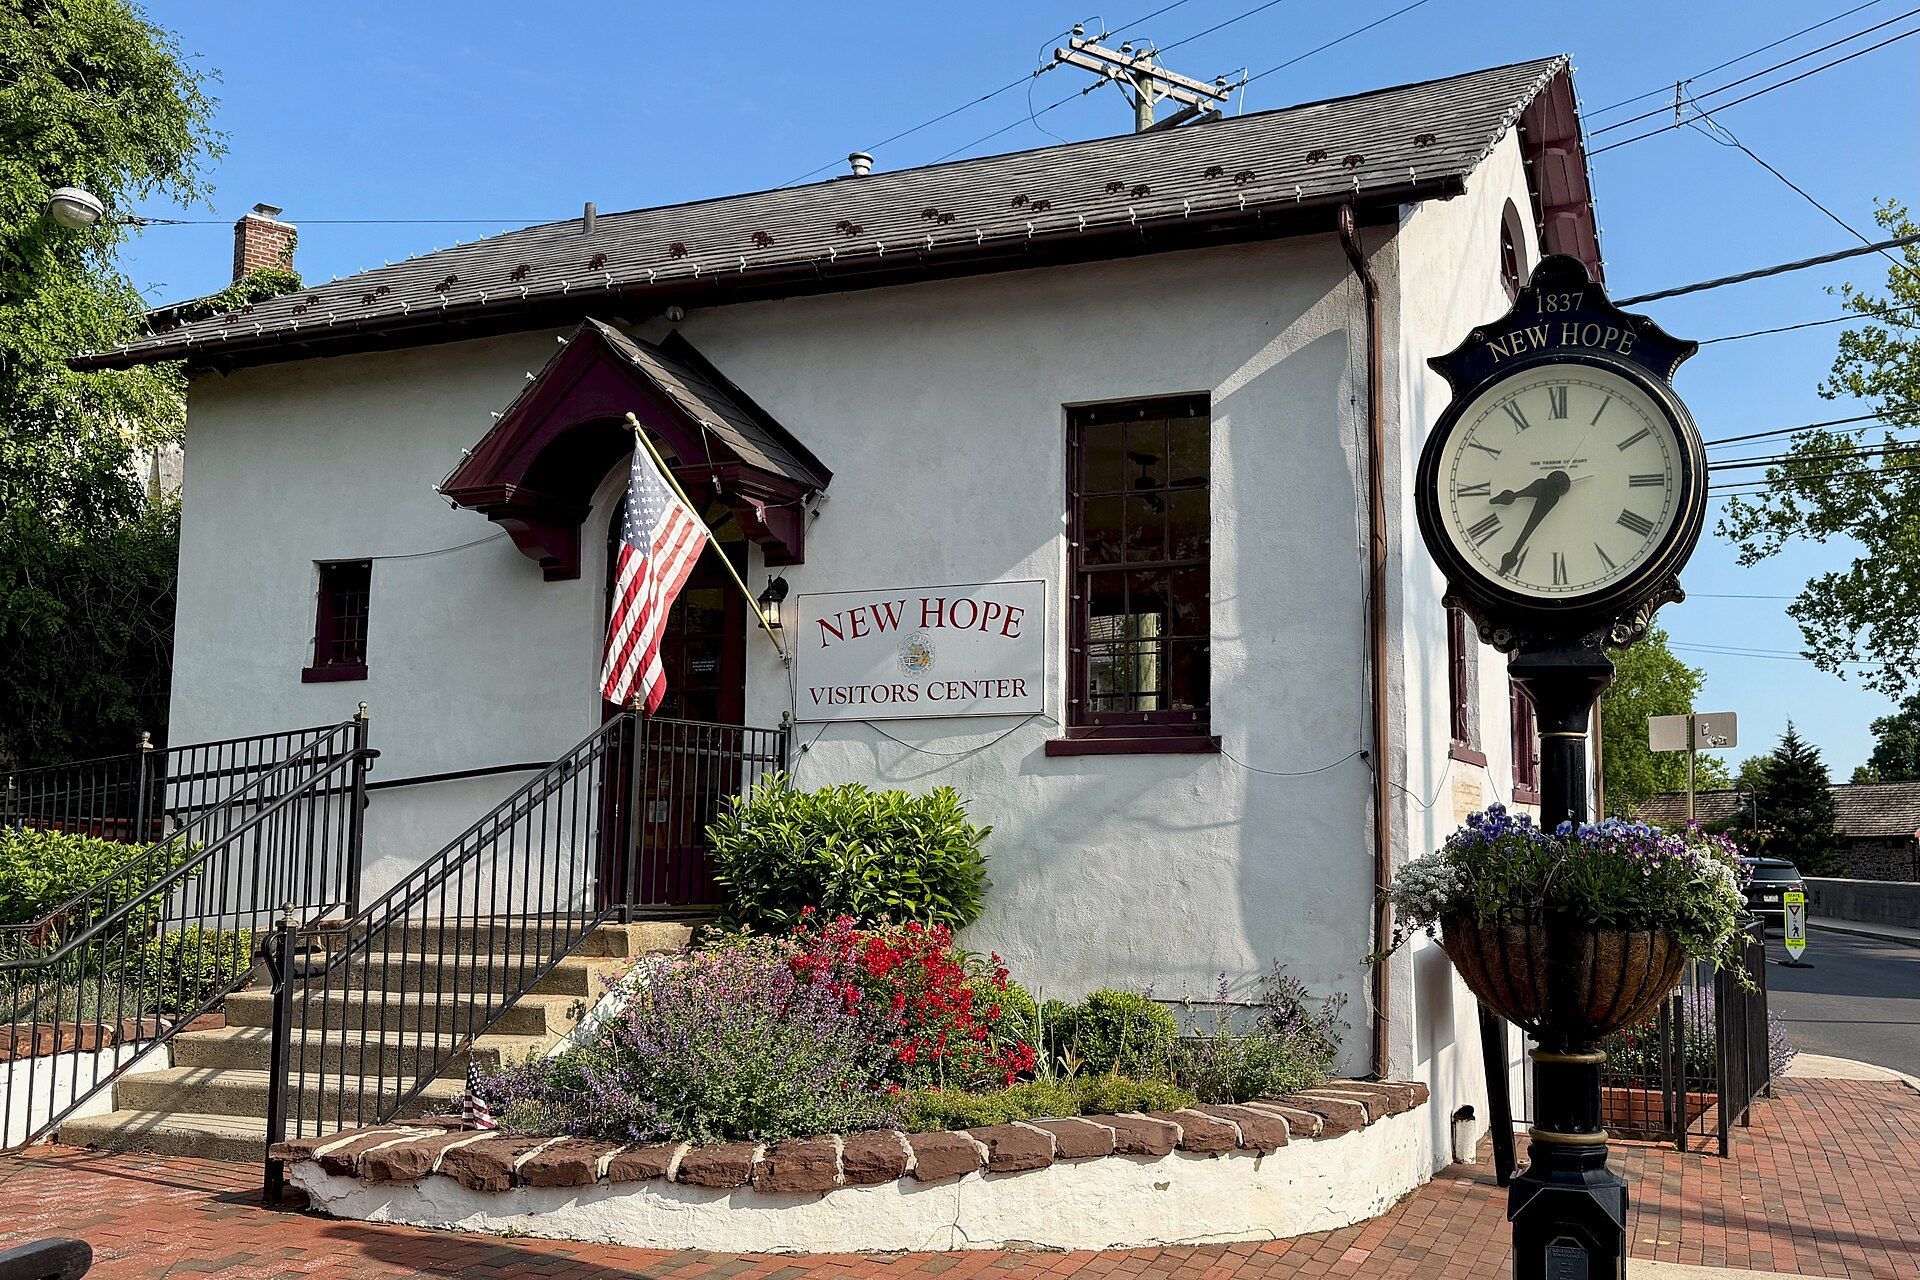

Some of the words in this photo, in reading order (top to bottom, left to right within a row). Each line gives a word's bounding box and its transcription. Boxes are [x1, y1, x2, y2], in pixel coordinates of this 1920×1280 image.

[1536, 292, 1584, 314] 1837
[1486, 323, 1550, 363] NEW
[1560, 322, 1638, 356] HOPE
[1502, 400, 1531, 435] XI
[1547, 386, 1569, 420] XII
[1468, 436, 1502, 461] X
[1628, 473, 1665, 488] III
[816, 599, 907, 649] NEW
[918, 597, 1025, 639] HOPE
[809, 683, 919, 706] VISITORS
[926, 678, 1029, 701] CENTER
